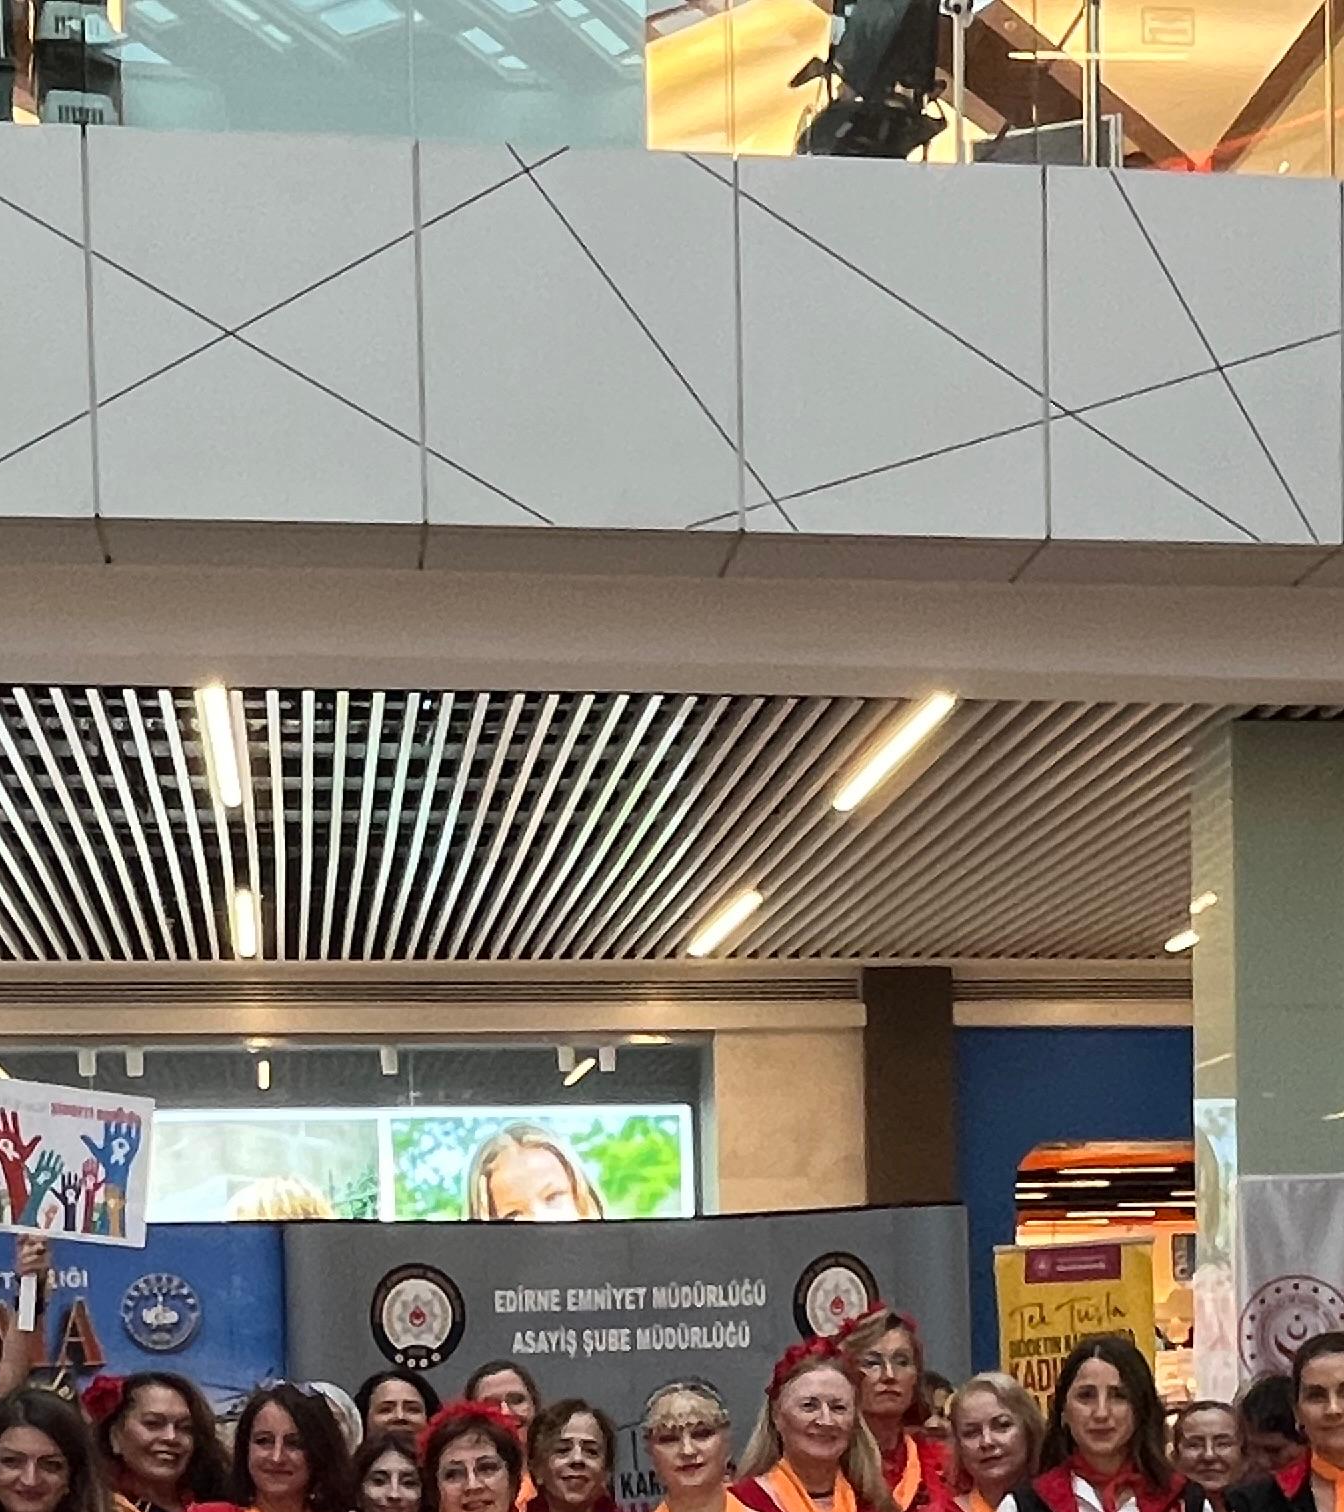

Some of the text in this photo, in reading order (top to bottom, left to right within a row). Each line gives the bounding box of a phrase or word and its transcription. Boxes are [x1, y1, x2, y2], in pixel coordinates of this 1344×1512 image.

[494, 1279, 766, 1312] EDİRNE EMNİYET MÜDÜRLÜĞÜ
[512, 1320, 750, 1358] ASAYİŞ ŞUBE MÜDÜRLÜĞÜ
